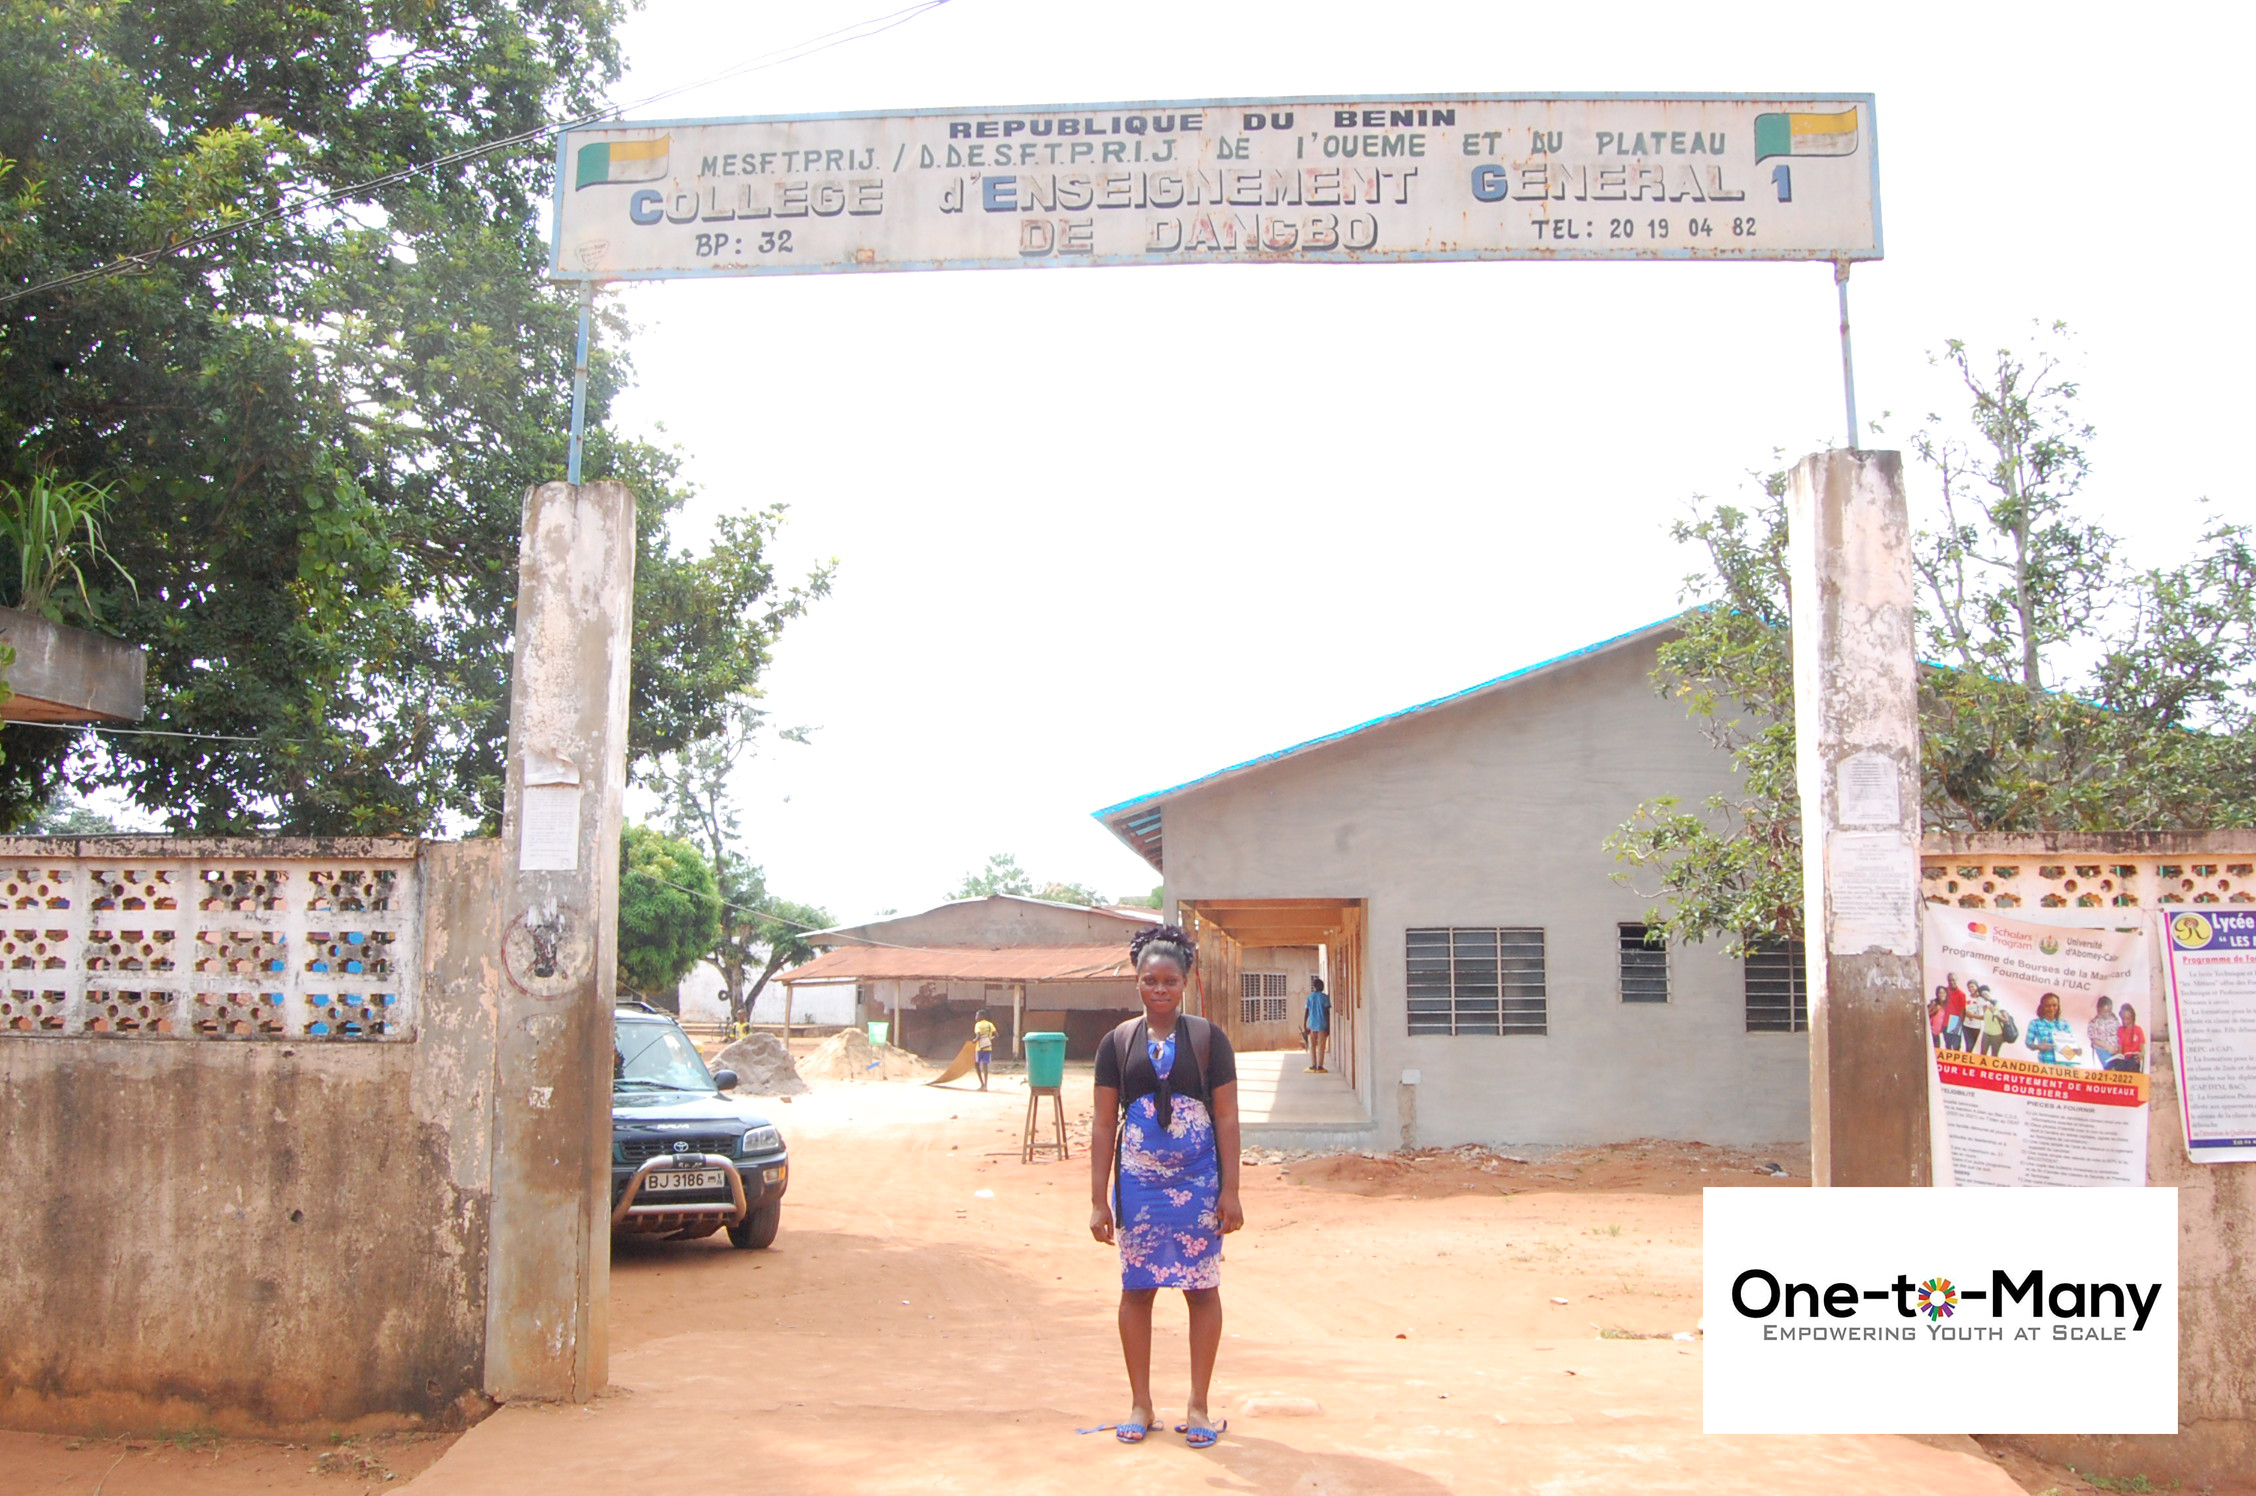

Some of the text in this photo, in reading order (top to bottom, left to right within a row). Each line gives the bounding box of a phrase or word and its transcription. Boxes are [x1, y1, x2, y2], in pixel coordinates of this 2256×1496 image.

[949, 109, 1455, 139] REPUBLIQUE DU BENIN
[893, 143, 905, 173] /
[1216, 136, 1250, 160] DE
[1462, 132, 1502, 156] ET
[1531, 131, 1563, 154] DU
[1595, 132, 1725, 156] PLATEAU
[629, 163, 1793, 226] COLLEGE d'ENSEIGNEMENT GENERAL 1
[1018, 212, 1378, 256] DE DANGBO
[1531, 217, 1756, 240] TEL: 20 19 04 82
[695, 229, 793, 257] BP: 32
[1993, 926, 2032, 941] Scholars
[2211, 913, 2255, 933] Lycée
[1992, 935, 2032, 950] Program
[2230, 936, 2250, 947] LES
[1942, 945, 2000, 964] Programme
[2003, 956, 2015, 967] de
[2018, 959, 2060, 975] Bourses
[2063, 967, 2076, 978] de
[2079, 969, 2088, 979] la
[2182, 956, 2231, 965] Programme
[2234, 954, 2243, 963] de
[1993, 966, 2051, 986] Foundation
[2054, 977, 2060, 987] à
[1937, 1051, 2133, 1084] APPEL A CANDIDATURE 2021-2022
[1962, 1068, 1975, 1077] LE
[1980, 1071, 2063, 1089] RECRUTEMENT
[2067, 1083, 2082, 1092] DE
[2086, 1084, 2135, 1096] NOUVEAUX
[2003, 1083, 2069, 1099] BOURSIERS
[2027, 1100, 2055, 1110] PIECES
[2063, 1105, 2095, 1114] FOURNIR
[648, 1175, 669, 1189] BJ
[673, 1173, 704, 1188] 3186
